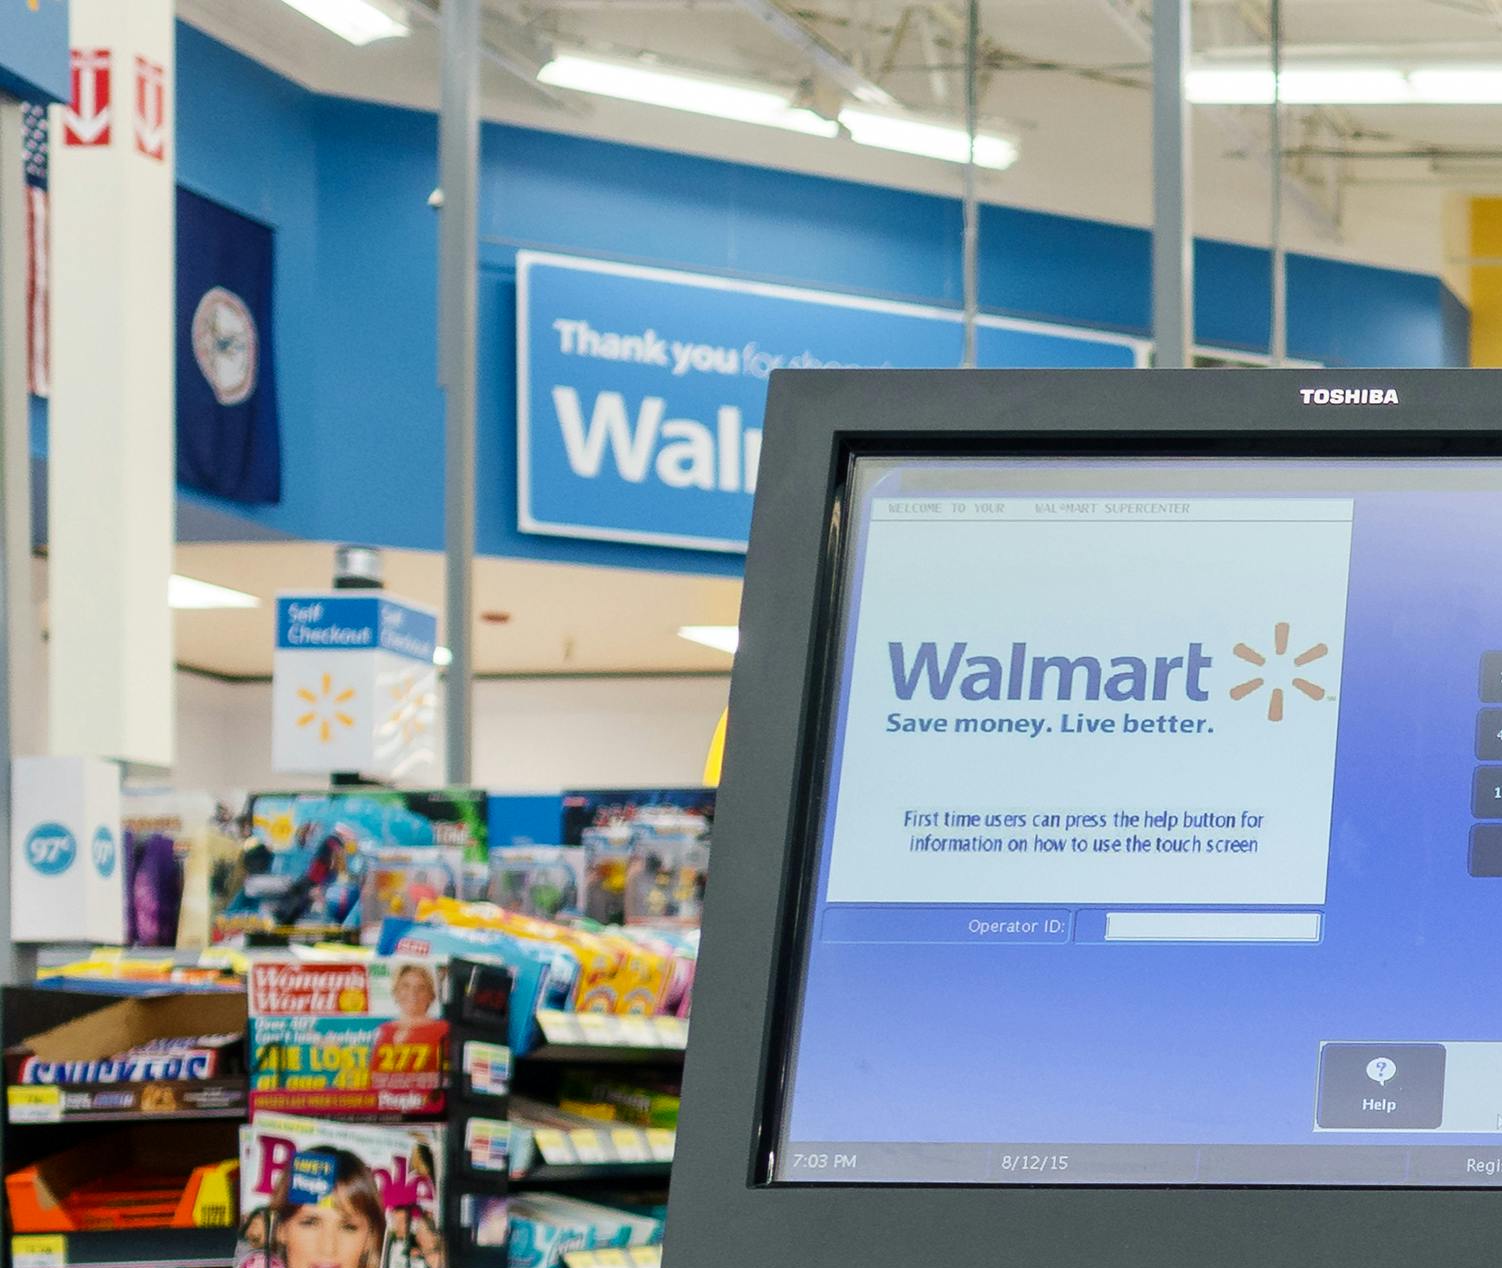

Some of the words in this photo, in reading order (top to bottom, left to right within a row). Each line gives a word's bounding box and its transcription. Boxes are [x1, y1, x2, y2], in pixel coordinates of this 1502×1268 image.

[553, 318, 668, 367] Thank
[670, 333, 739, 377] you
[1299, 389, 1399, 404] TOSHIBA
[552, 386, 764, 494] Wal
[888, 503, 943, 514] WELCOME
[951, 503, 966, 514] TO
[974, 503, 1005, 514] YOUR
[1105, 503, 1190, 514] SUPERCENTER
[287, 602, 324, 623] Self
[287, 624, 372, 645] Checkout
[887, 641, 1214, 702] Walmart
[886, 712, 948, 734] Save
[954, 717, 1053, 738] money.
[1060, 712, 1115, 734] Live
[1122, 712, 1215, 734] better.
[1494, 787, 1502, 799] 1
[903, 810, 939, 828] First
[944, 810, 981, 828] time
[985, 813, 1027, 828] users
[1032, 815, 1060, 828] can
[1066, 815, 1107, 832] press
[1113, 811, 1140, 829] the
[1143, 811, 1178, 832] help
[1183, 811, 1236, 829] button
[1240, 811, 1265, 830] for
[909, 834, 1003, 853] information
[1007, 839, 1028, 853] on
[1033, 834, 1067, 853] how
[1071, 836, 1089, 853] to
[1093, 839, 1122, 853] use
[1126, 835, 1152, 853] the
[1155, 835, 1201, 853] touch
[1206, 838, 1259, 853] screen
[968, 918, 1039, 934] Operator
[1044, 919, 1066, 933] ID:
[255, 965, 366, 992] Woman's
[255, 990, 340, 1014] World
[309, 1045, 370, 1072] LOST
[378, 1043, 431, 1073] 277
[1362, 1098, 1397, 1114] Help
[793, 1154, 828, 1169] 7:03
[834, 1155, 857, 1168] PM
[1002, 1155, 1069, 1171] 8/12/15
